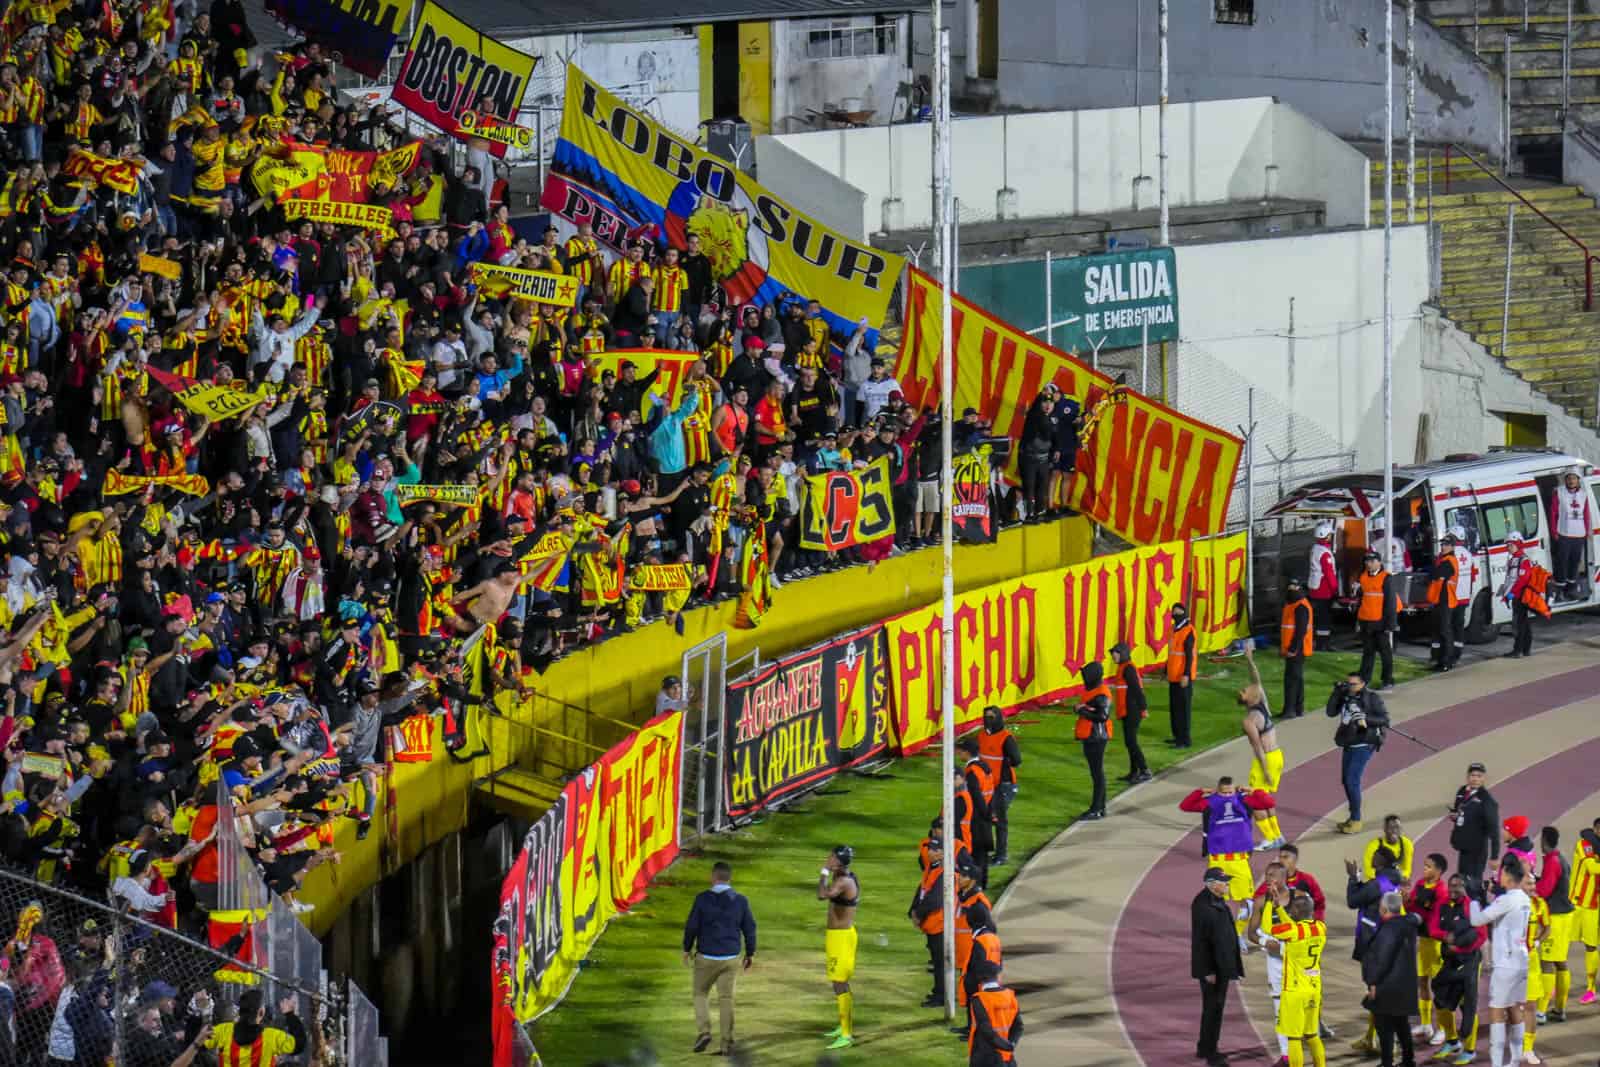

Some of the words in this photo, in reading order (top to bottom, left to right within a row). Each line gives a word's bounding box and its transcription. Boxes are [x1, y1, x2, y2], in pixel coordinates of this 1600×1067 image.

[404, 22, 522, 120] BOSTON
[287, 202, 387, 225] VERSALLES
[582, 80, 737, 203] LOBO
[753, 194, 887, 290] SUR
[1084, 259, 1171, 305] SALIDA
[1085, 312, 1100, 333] DE
[897, 583, 1037, 737] POCHO
[1063, 548, 1174, 678] VIVE
[736, 655, 824, 744] AGUANTE
[759, 712, 831, 794] CAPILLA
[1304, 944, 1320, 971] 5
